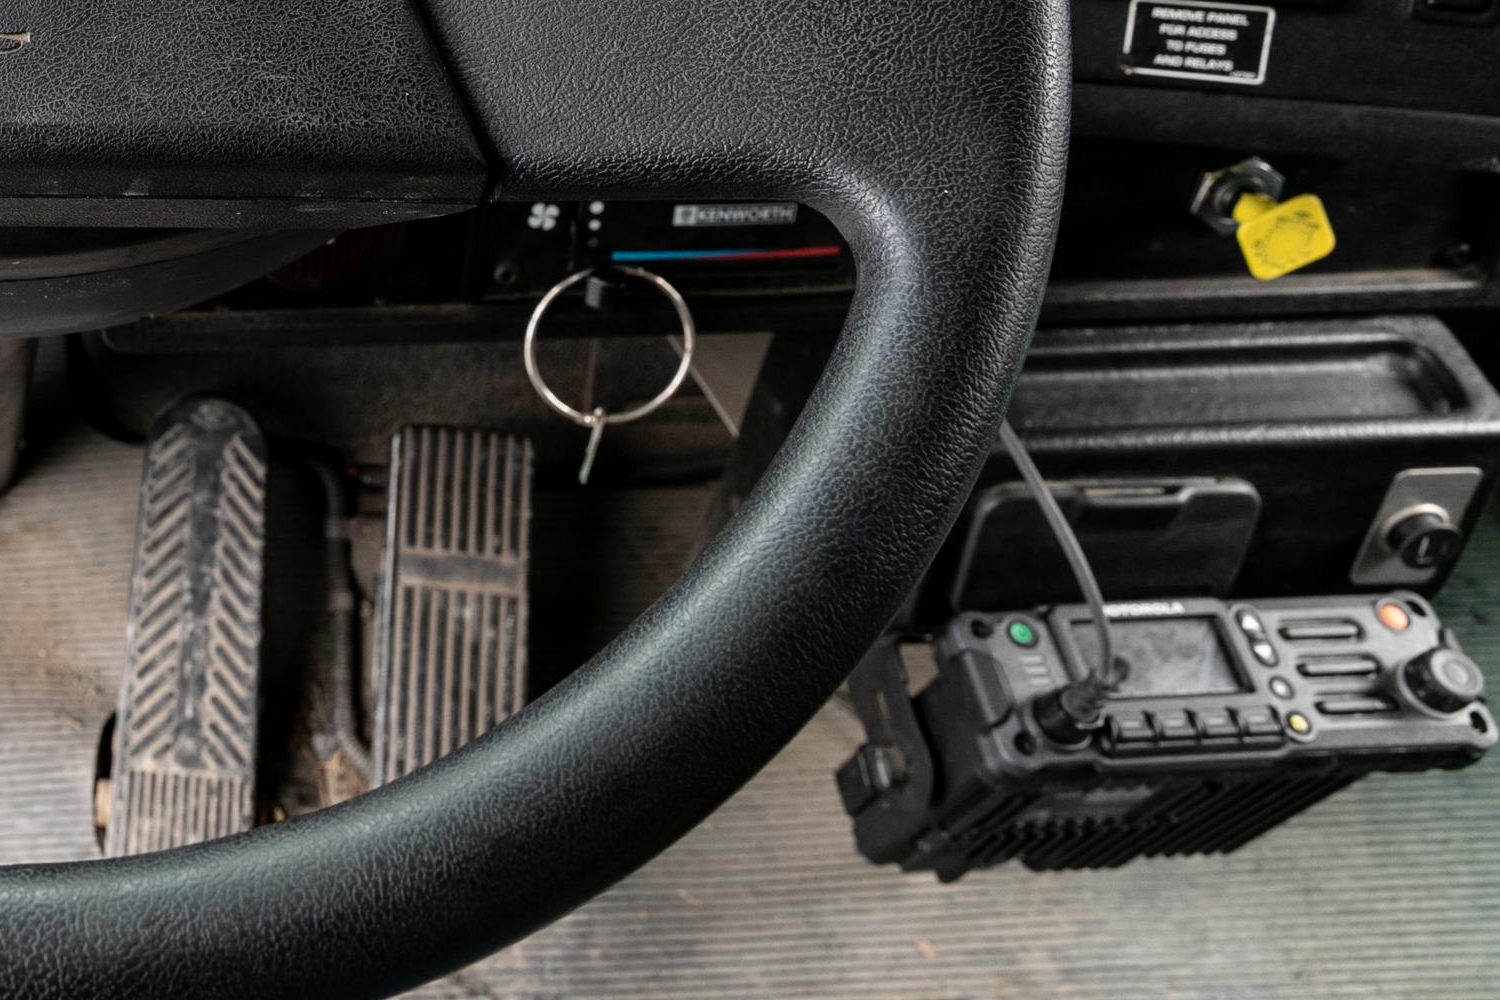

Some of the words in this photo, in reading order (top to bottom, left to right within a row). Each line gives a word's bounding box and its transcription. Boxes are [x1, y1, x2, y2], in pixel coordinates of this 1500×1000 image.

[1152, 7, 1205, 22] REMOVE
[1206, 11, 1250, 27] PANEL
[1158, 23, 1186, 36] FOR
[1187, 26, 1238, 41] ACCESS
[1166, 39, 1184, 52] TO
[1185, 41, 1227, 56] FUSES
[1153, 54, 1183, 67] AND
[1184, 56, 1234, 72] RELAYS
[699, 206, 794, 222] KENWORTH
[1102, 602, 1186, 617] OTOROLA
